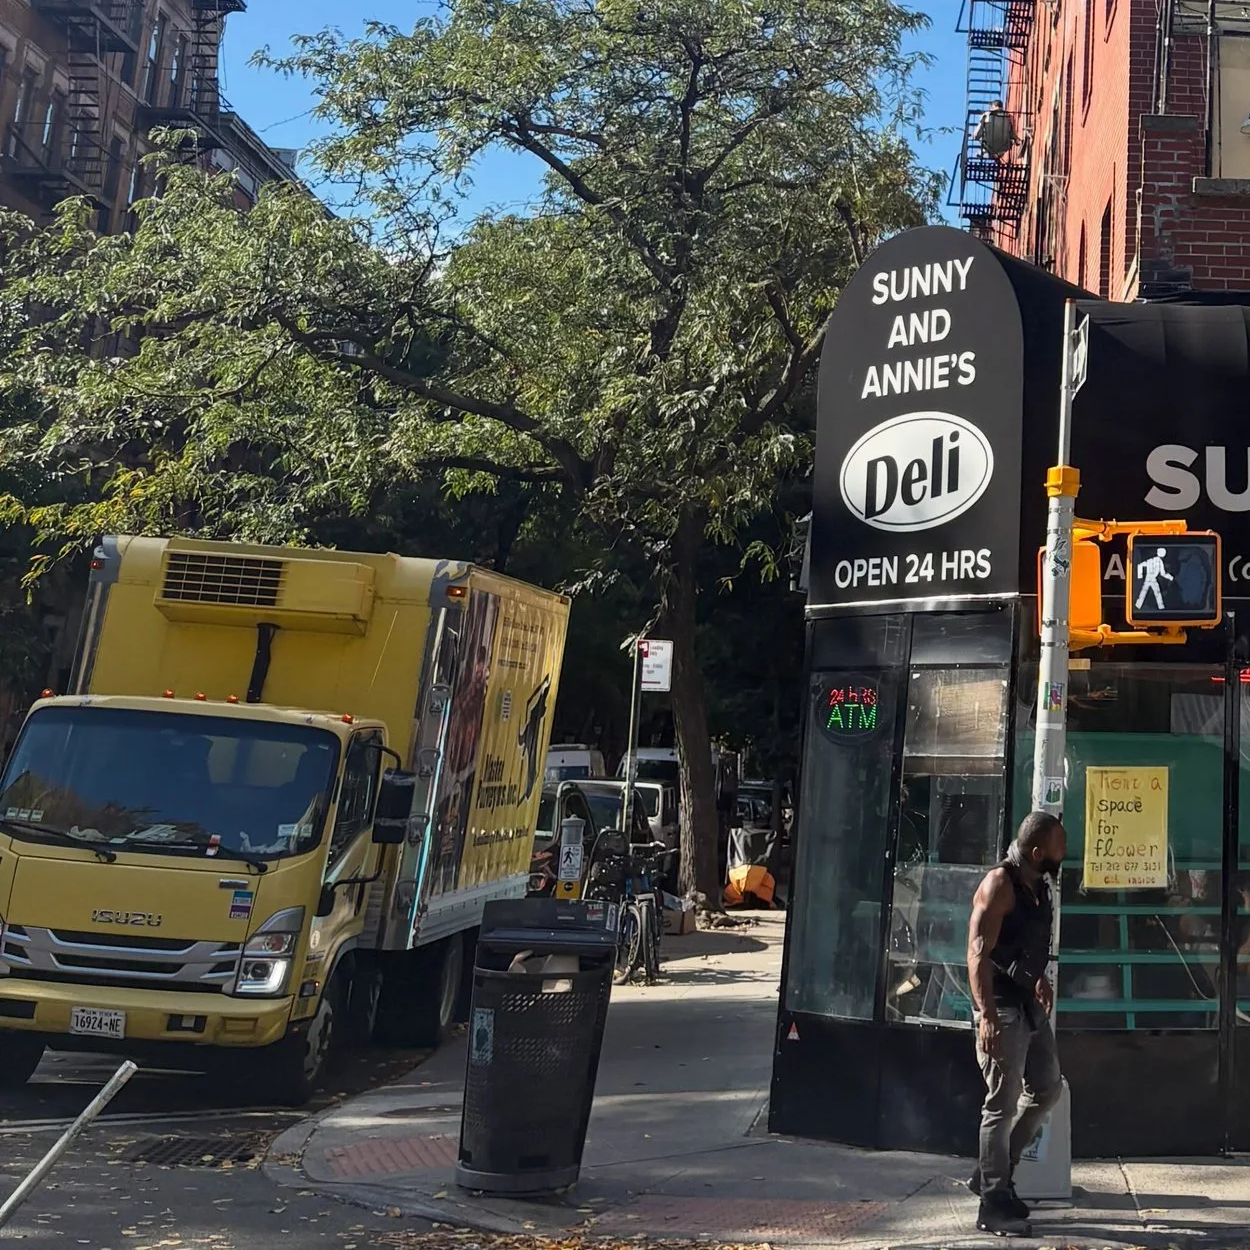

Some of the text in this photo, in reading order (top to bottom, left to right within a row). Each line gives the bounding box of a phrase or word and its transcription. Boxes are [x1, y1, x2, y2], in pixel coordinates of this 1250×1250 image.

[872, 257, 974, 305] SUNNY
[888, 308, 952, 349] AND
[861, 352, 976, 399] ANNIE'S
[864, 430, 961, 520] Deli
[835, 549, 992, 589] OPEN 24 HRS
[829, 689, 845, 705] 24
[826, 703, 877, 729] ATM
[1097, 797, 1143, 817] space
[1097, 819, 1119, 836] for
[1094, 838, 1159, 858] flower
[92, 910, 163, 927] ISUZU
